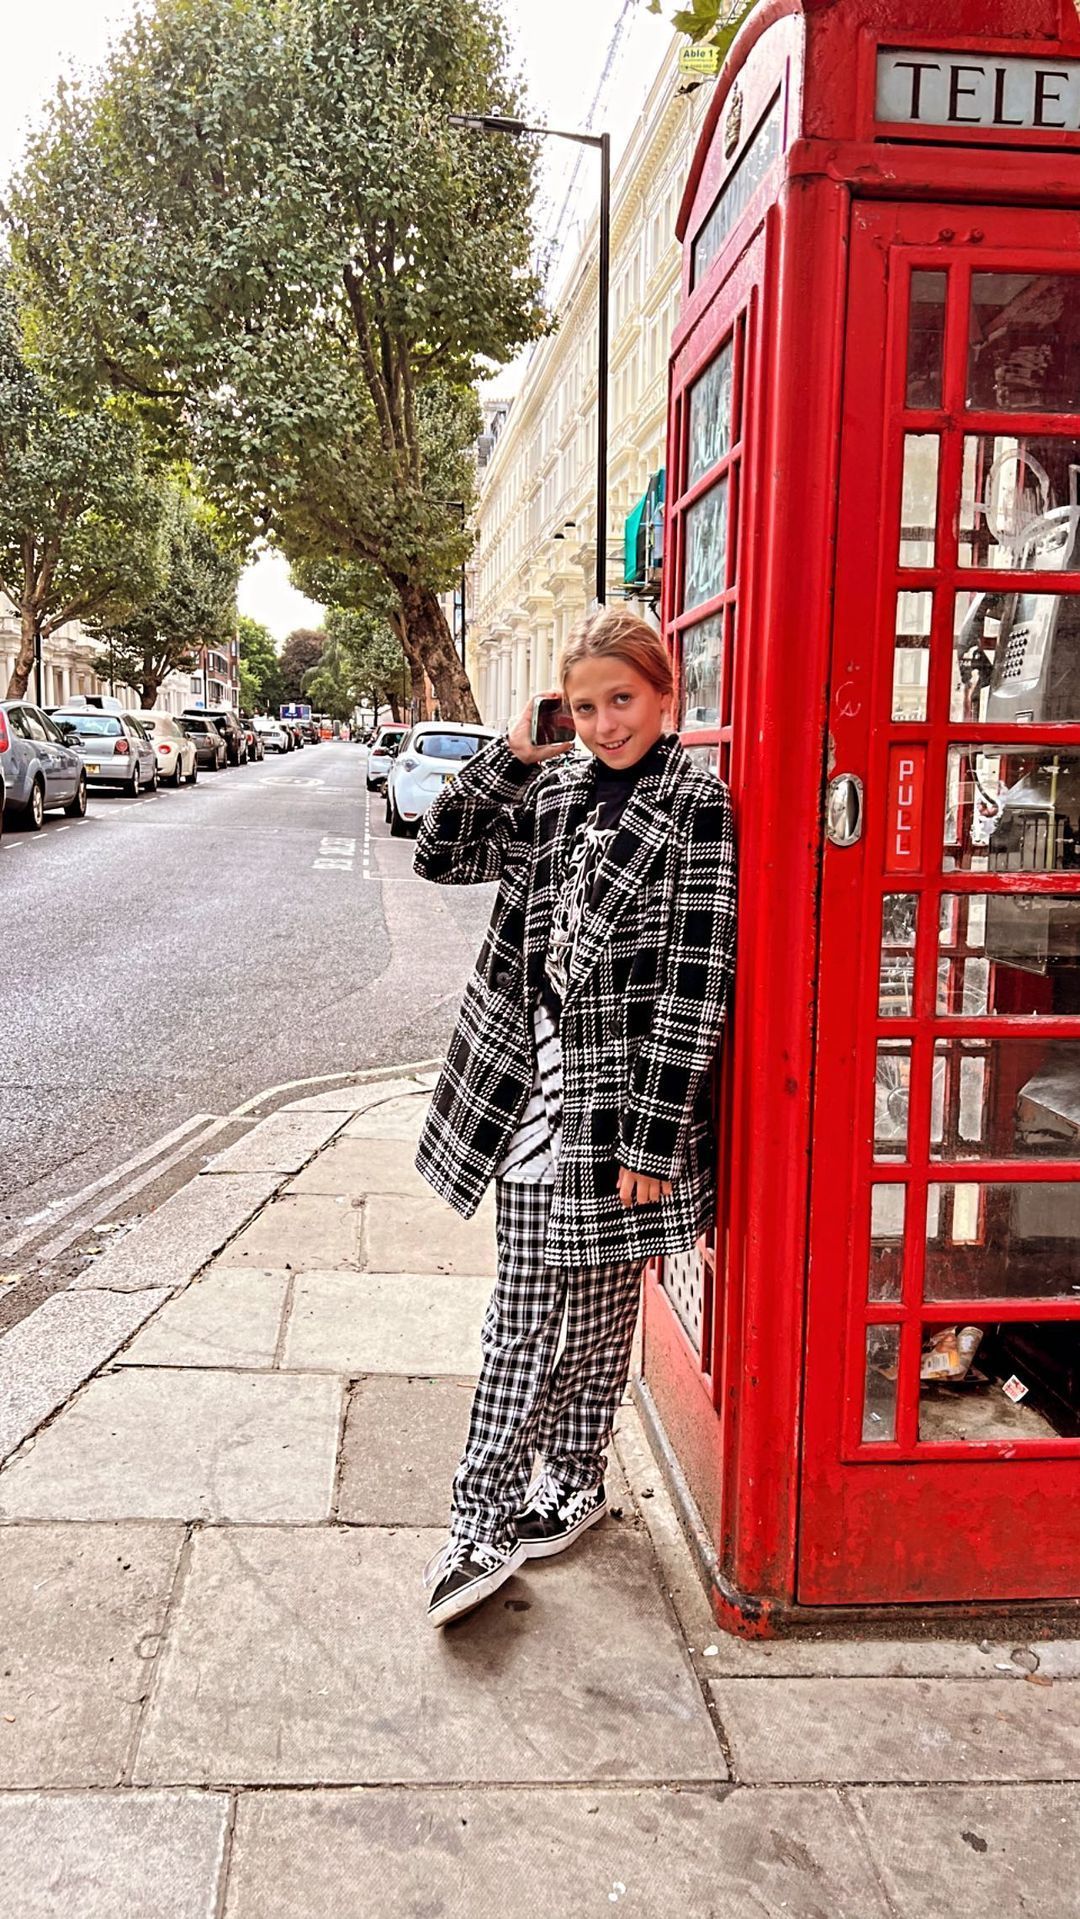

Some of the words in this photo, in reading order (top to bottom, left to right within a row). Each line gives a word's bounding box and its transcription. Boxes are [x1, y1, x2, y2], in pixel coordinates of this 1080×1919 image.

[683, 49, 706, 58] Able
[708, 49, 713, 58] 1
[893, 61, 1080, 128] TELE
[895, 759, 915, 855] PULL
